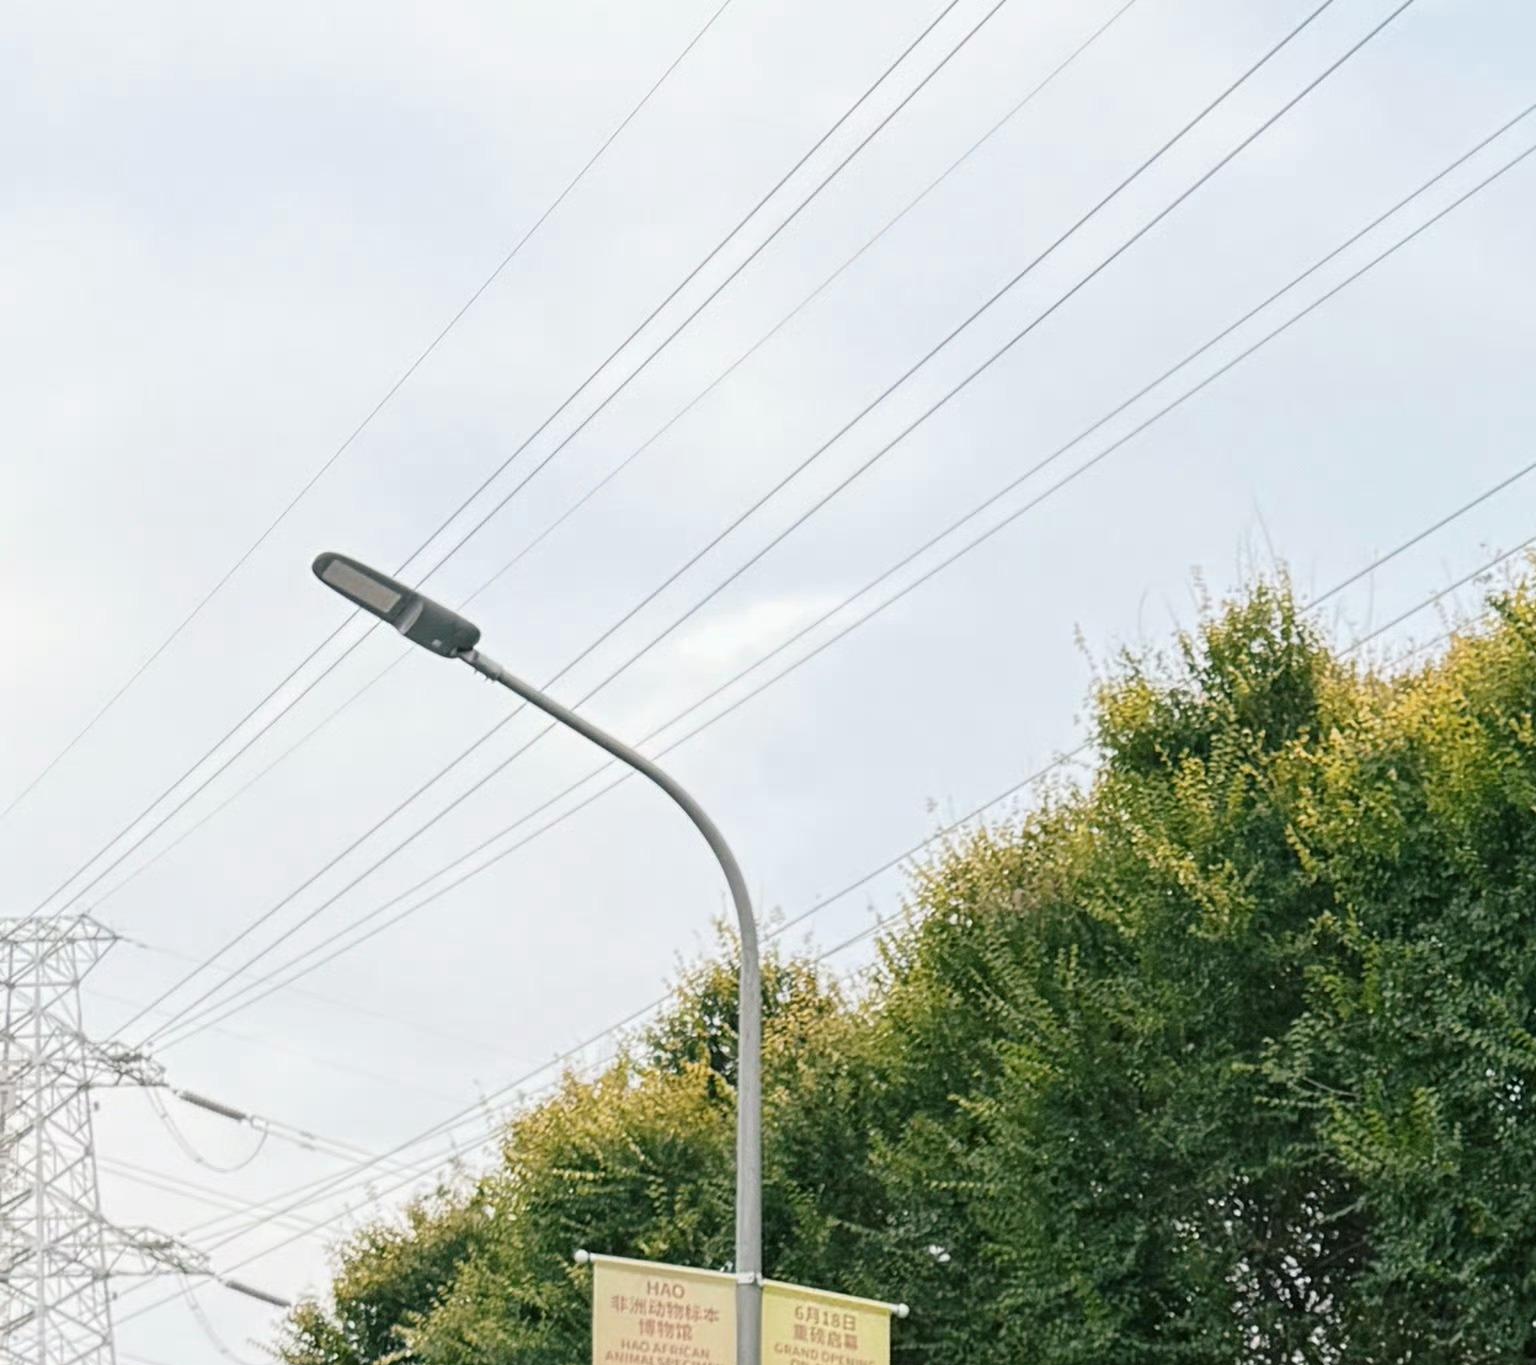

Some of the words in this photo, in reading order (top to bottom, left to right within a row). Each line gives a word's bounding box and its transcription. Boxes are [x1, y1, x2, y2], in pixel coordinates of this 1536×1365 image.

[646, 1281, 686, 1300] HAO
[610, 1294, 720, 1323] 非洲动物标本
[794, 1305, 857, 1332] 6月18日
[638, 1318, 694, 1341] 博物馆
[621, 1339, 650, 1354] HAO
[652, 1342, 711, 1360] AFRICAN
[774, 1342, 819, 1362] GRAND
